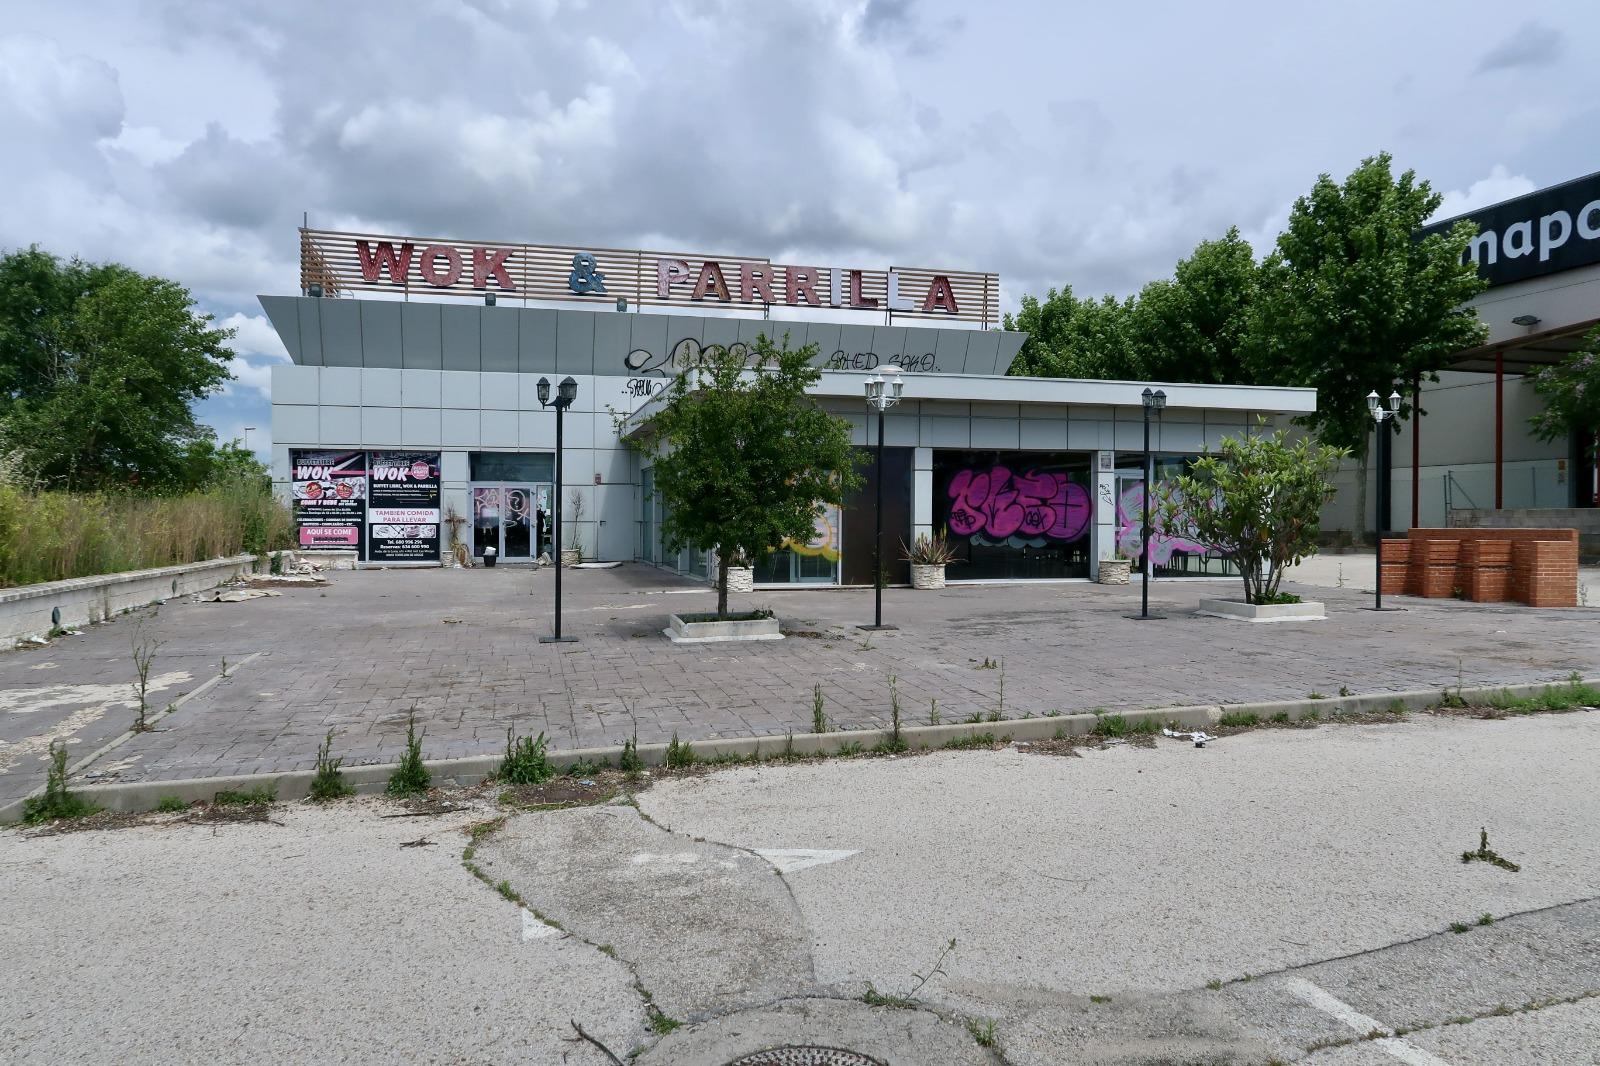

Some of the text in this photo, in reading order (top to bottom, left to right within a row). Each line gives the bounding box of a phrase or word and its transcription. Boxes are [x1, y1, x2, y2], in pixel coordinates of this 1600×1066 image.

[356, 240, 959, 313] WOK & PARRILLA
[297, 466, 332, 481] WOK
[373, 467, 409, 482] WOK
